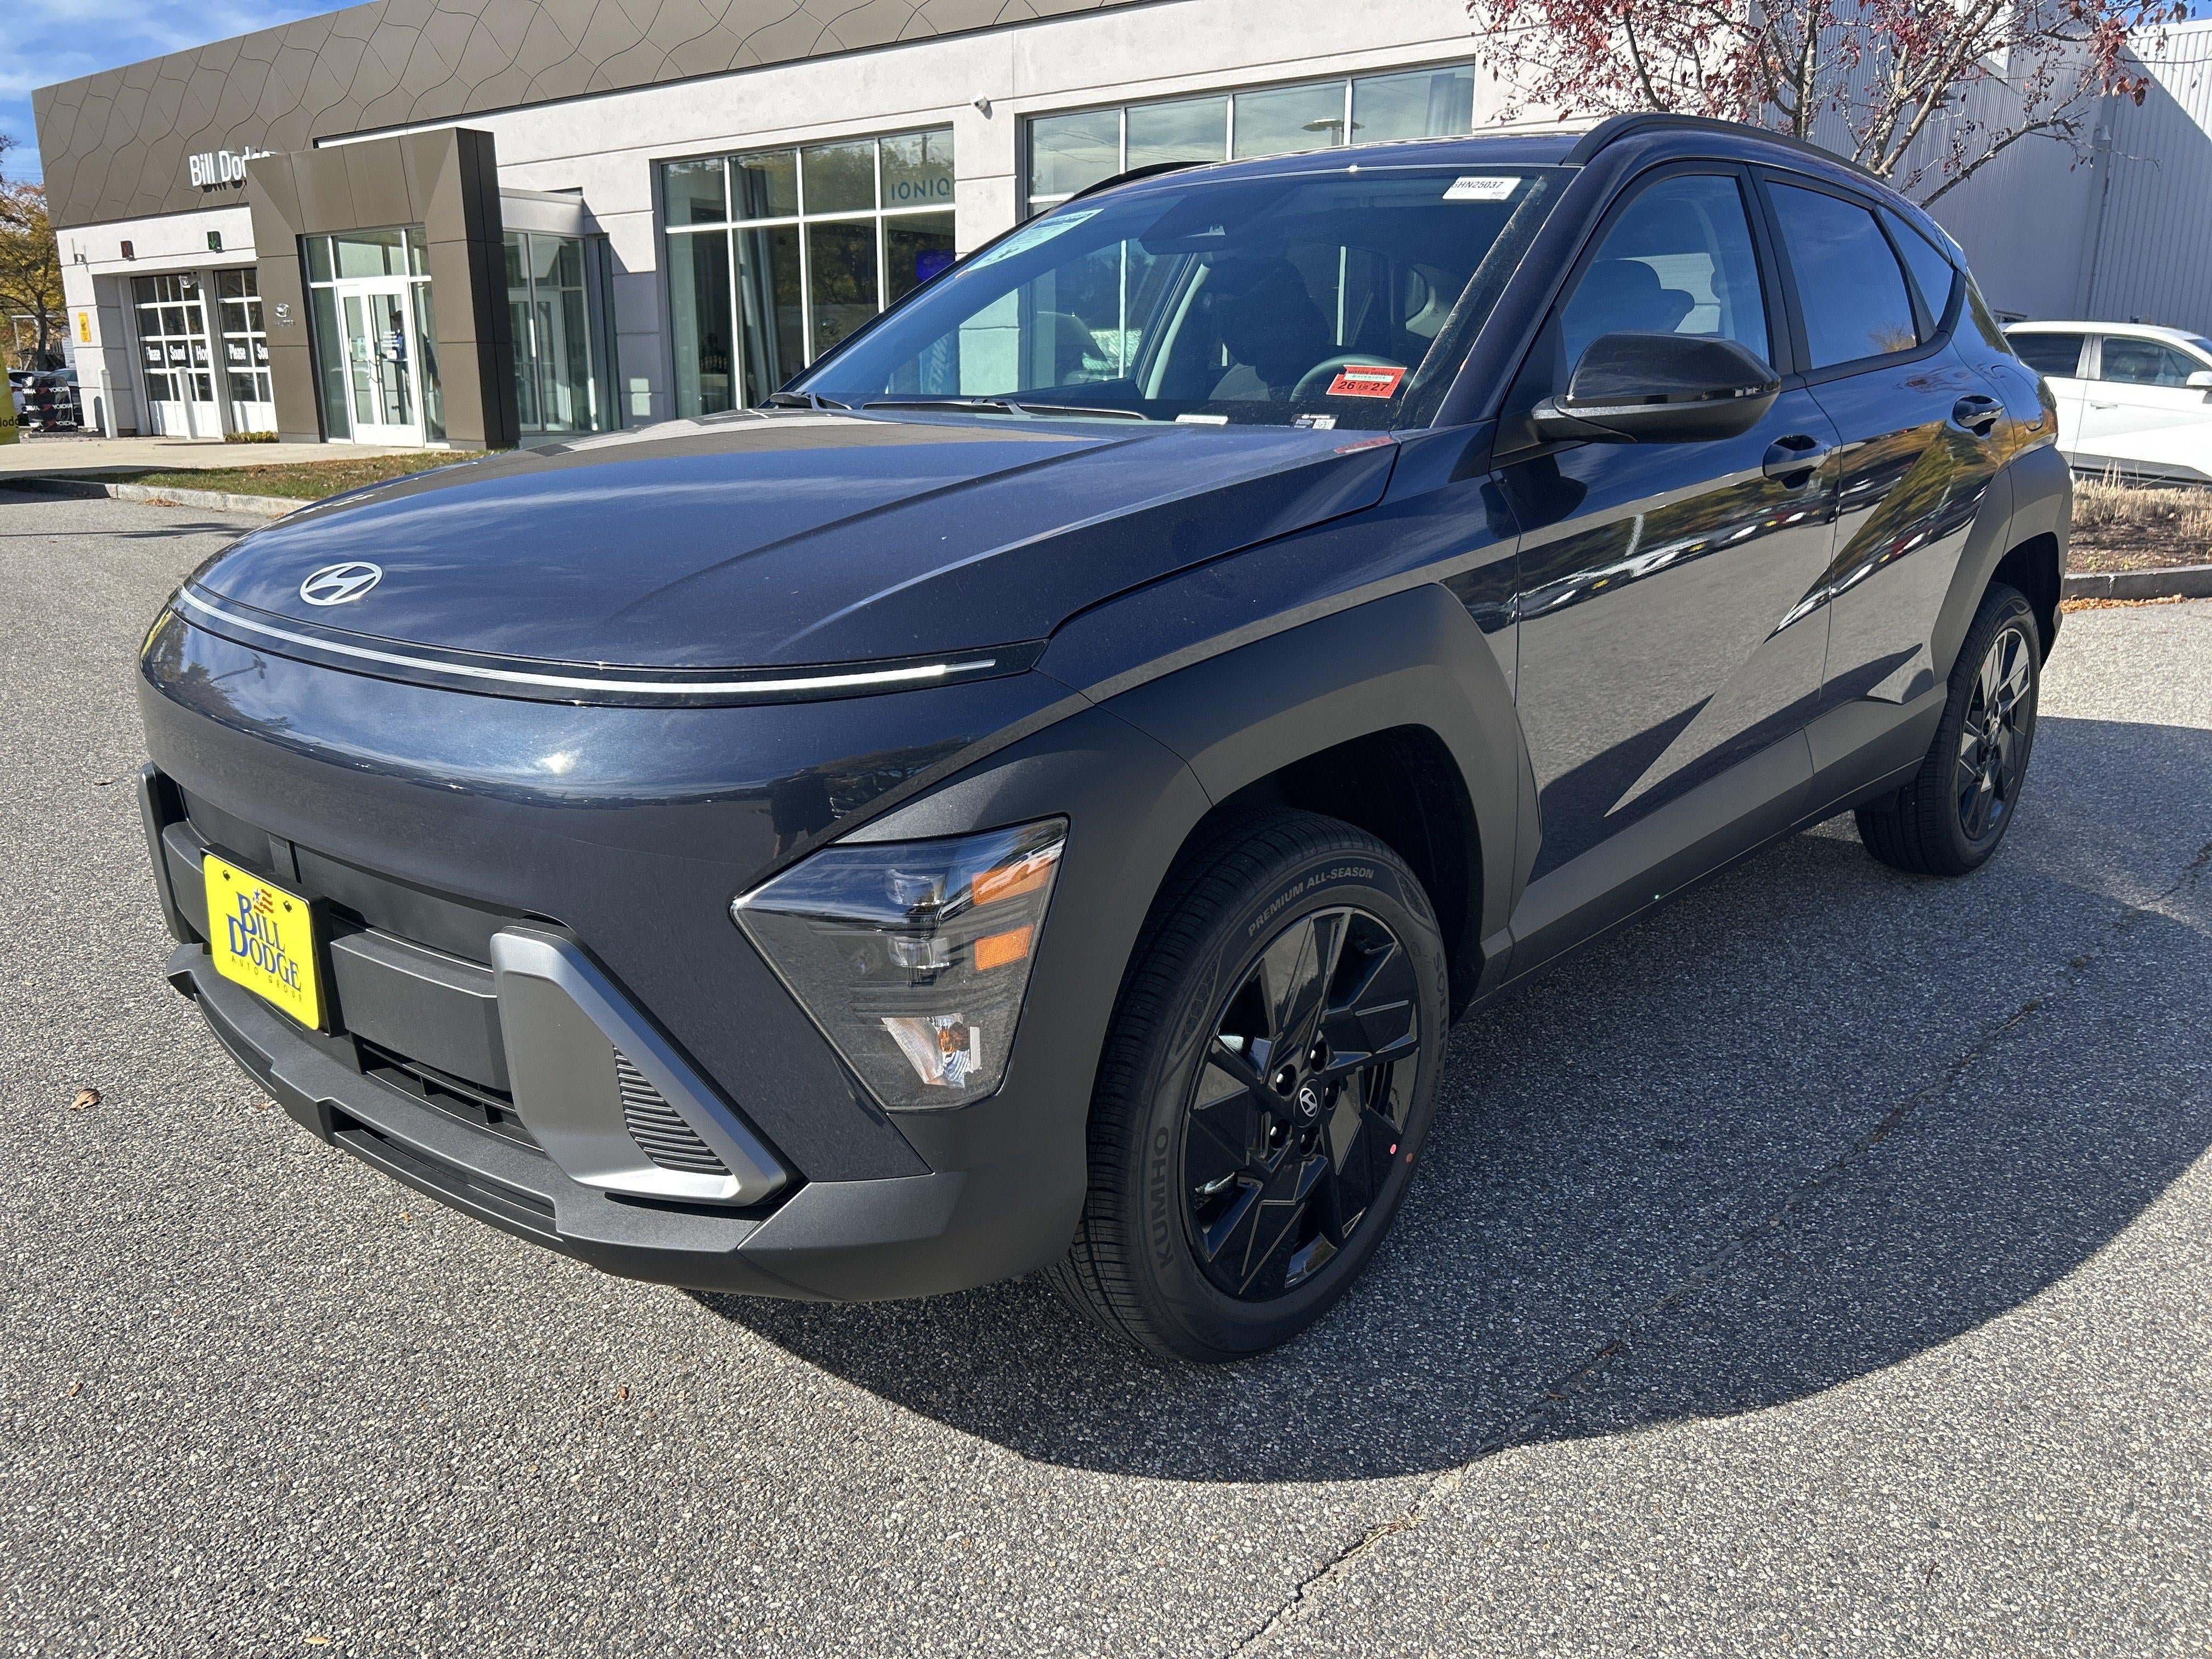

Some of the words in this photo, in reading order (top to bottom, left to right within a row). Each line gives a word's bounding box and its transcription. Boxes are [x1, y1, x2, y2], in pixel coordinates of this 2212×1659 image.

[189, 152, 216, 187] Bill
[218, 146, 270, 182] Dod
[891, 177, 950, 200] IONIQ
[1338, 381, 1356, 390] 26
[1370, 382, 1390, 391] 27
[236, 891, 285, 953] BILL
[1247, 882, 1304, 938] PREMIUM
[1307, 867, 1374, 889] ALL-SEASON
[226, 913, 301, 992] DODGE
[232, 957, 258, 976] AUTO
[268, 974, 302, 1003] GROUP
[1433, 951, 1446, 1063] SOLUS
[1150, 1126, 1175, 1270] KUMHO
